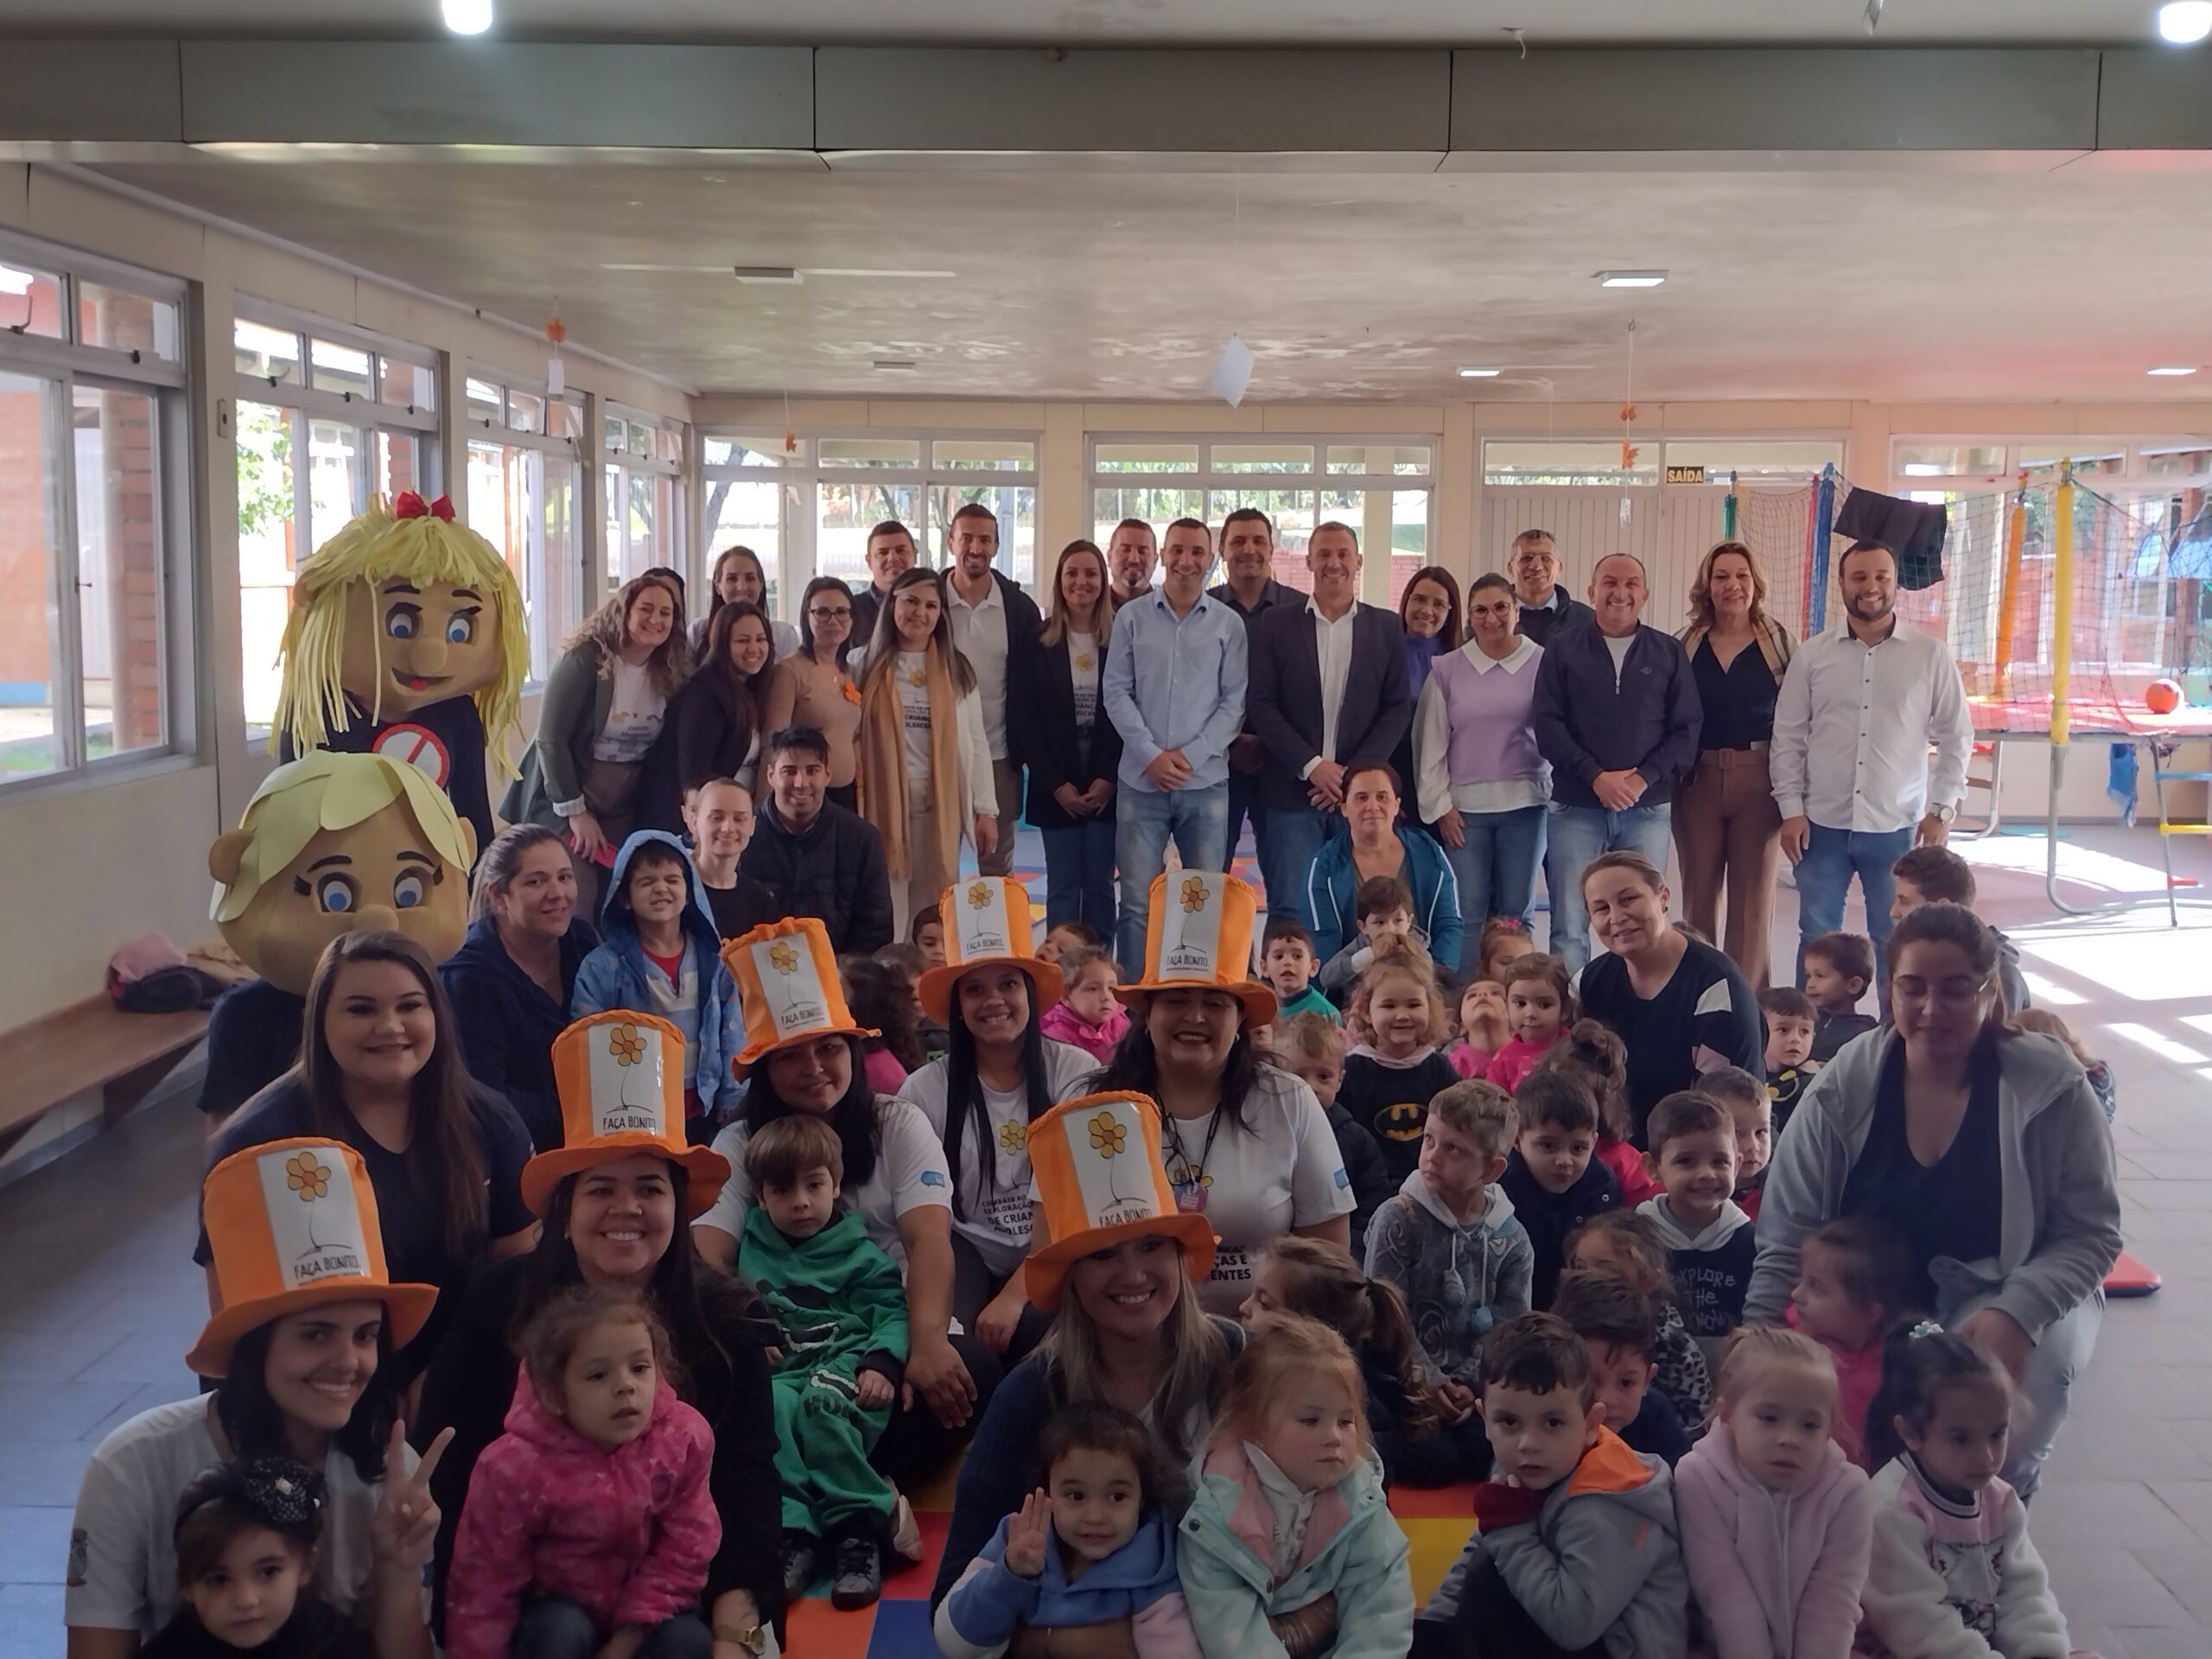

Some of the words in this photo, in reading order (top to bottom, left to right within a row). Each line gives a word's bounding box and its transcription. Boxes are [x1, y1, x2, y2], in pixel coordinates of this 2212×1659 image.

[1668, 467, 1703, 483] SAÍDA
[603, 1117, 626, 1130] FAÇA
[1003, 1211, 1033, 1224] CRIAN
[1213, 1255, 1237, 1269] ÇAS
[294, 1260, 322, 1280] FAÇA
[1211, 1268, 1251, 1281] ENTES
